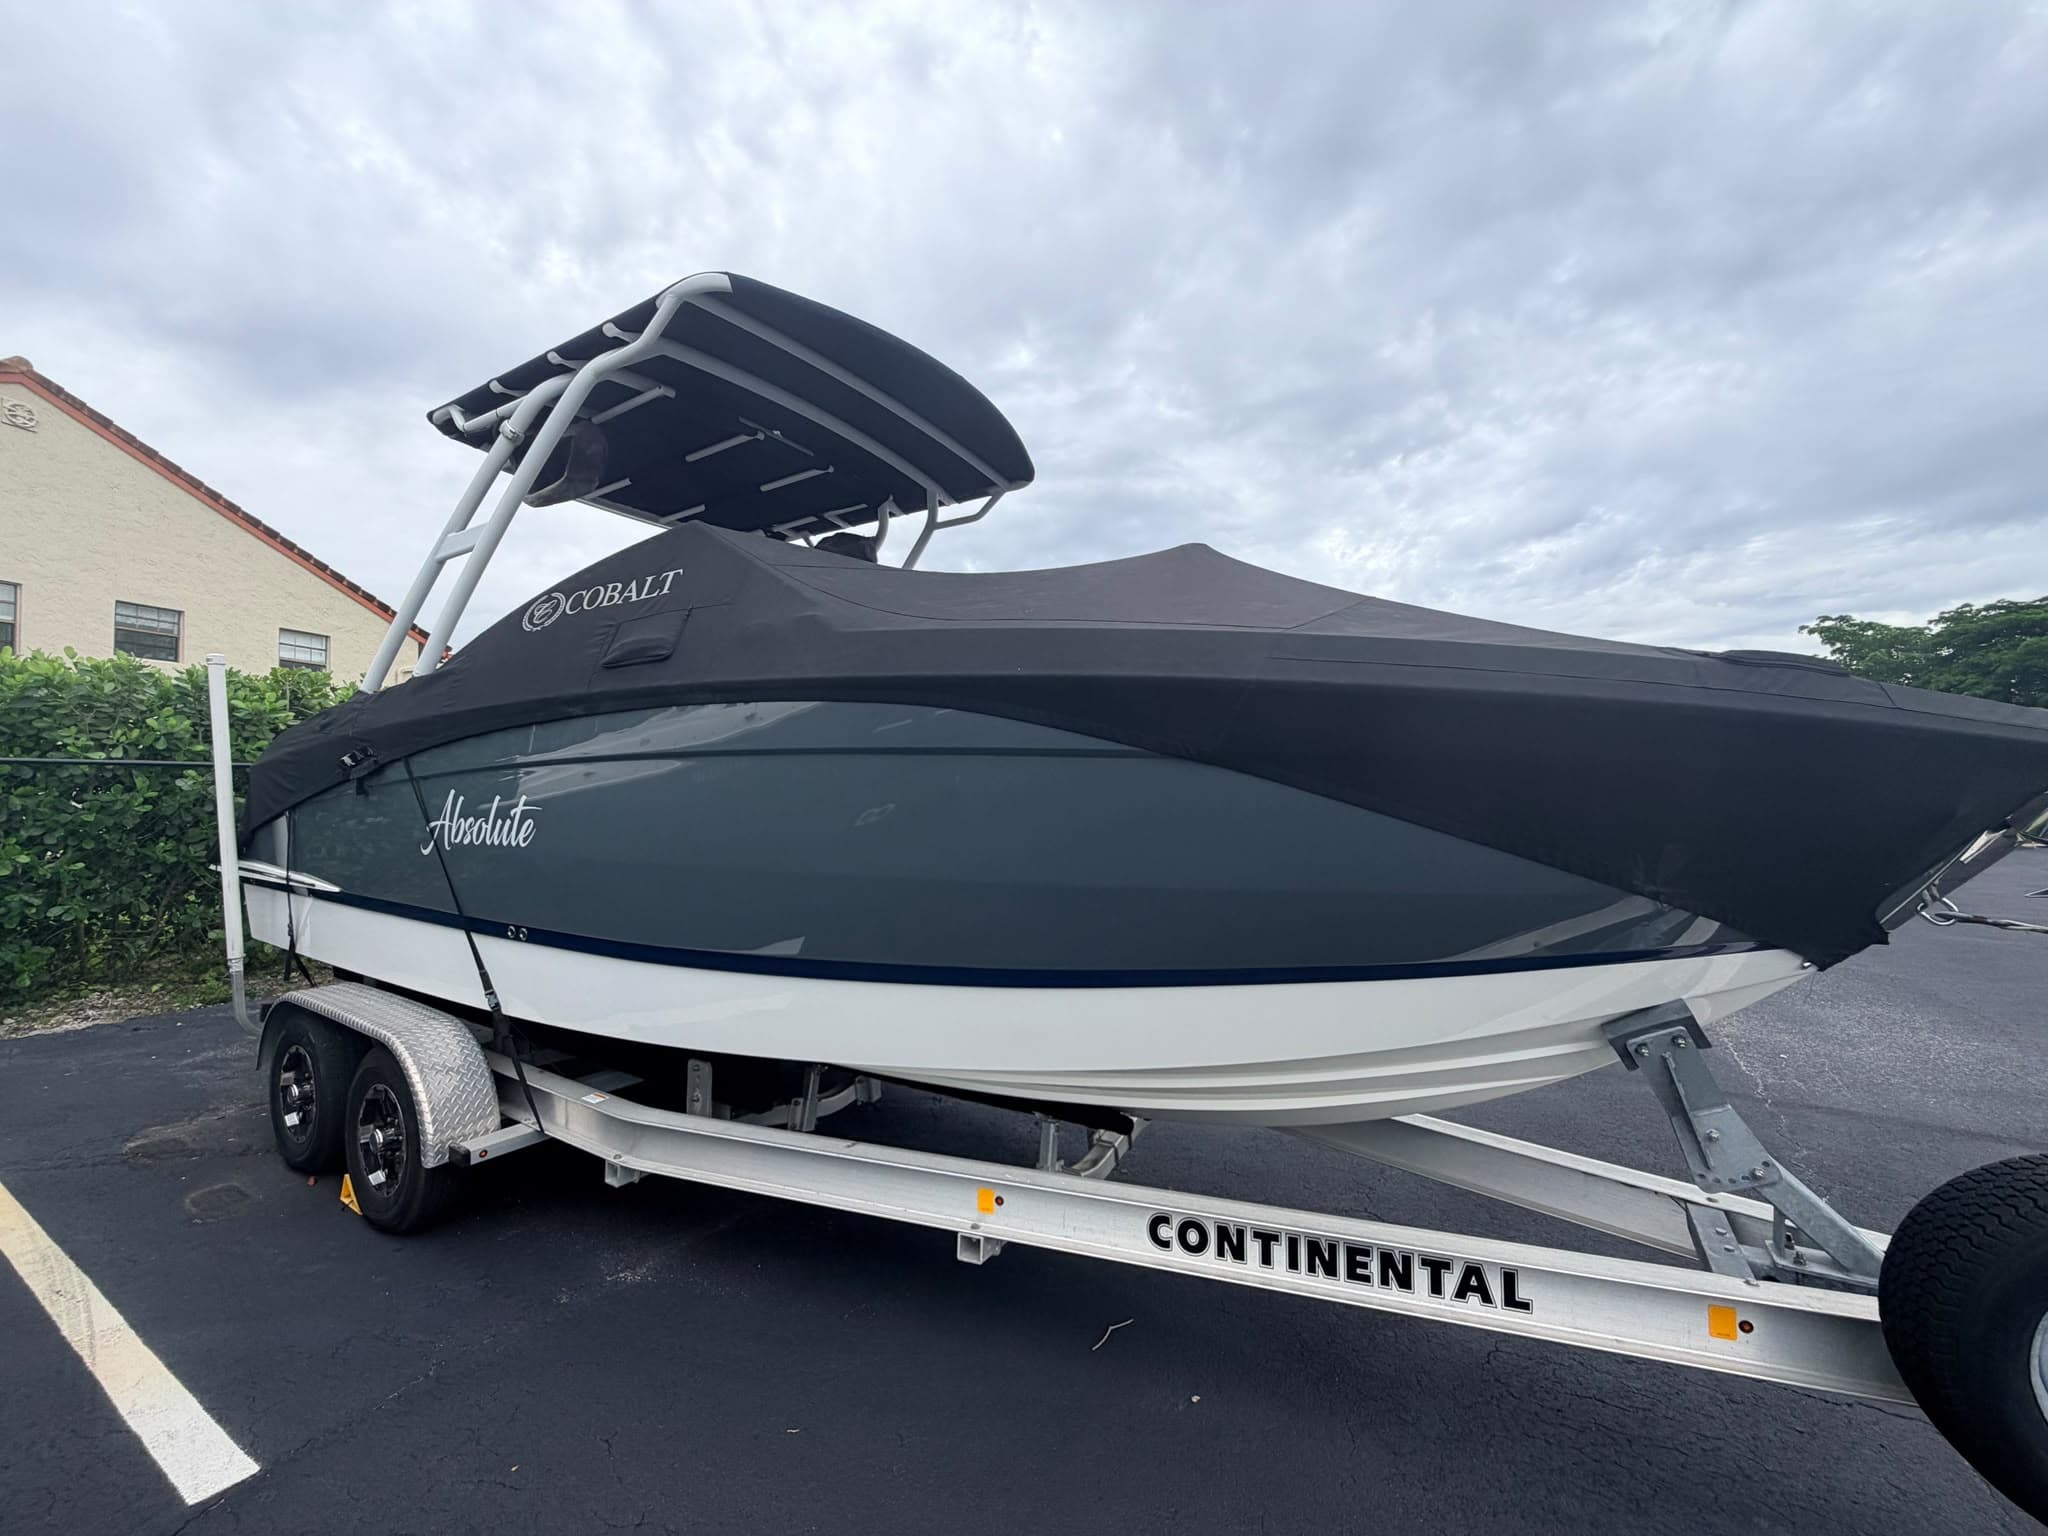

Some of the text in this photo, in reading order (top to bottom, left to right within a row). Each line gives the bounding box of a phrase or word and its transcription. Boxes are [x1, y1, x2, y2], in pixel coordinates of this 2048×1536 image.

[565, 569, 683, 615] COBALT
[420, 788, 542, 855] Absolute
[1147, 1213, 1533, 1314] CONTINENTAL
